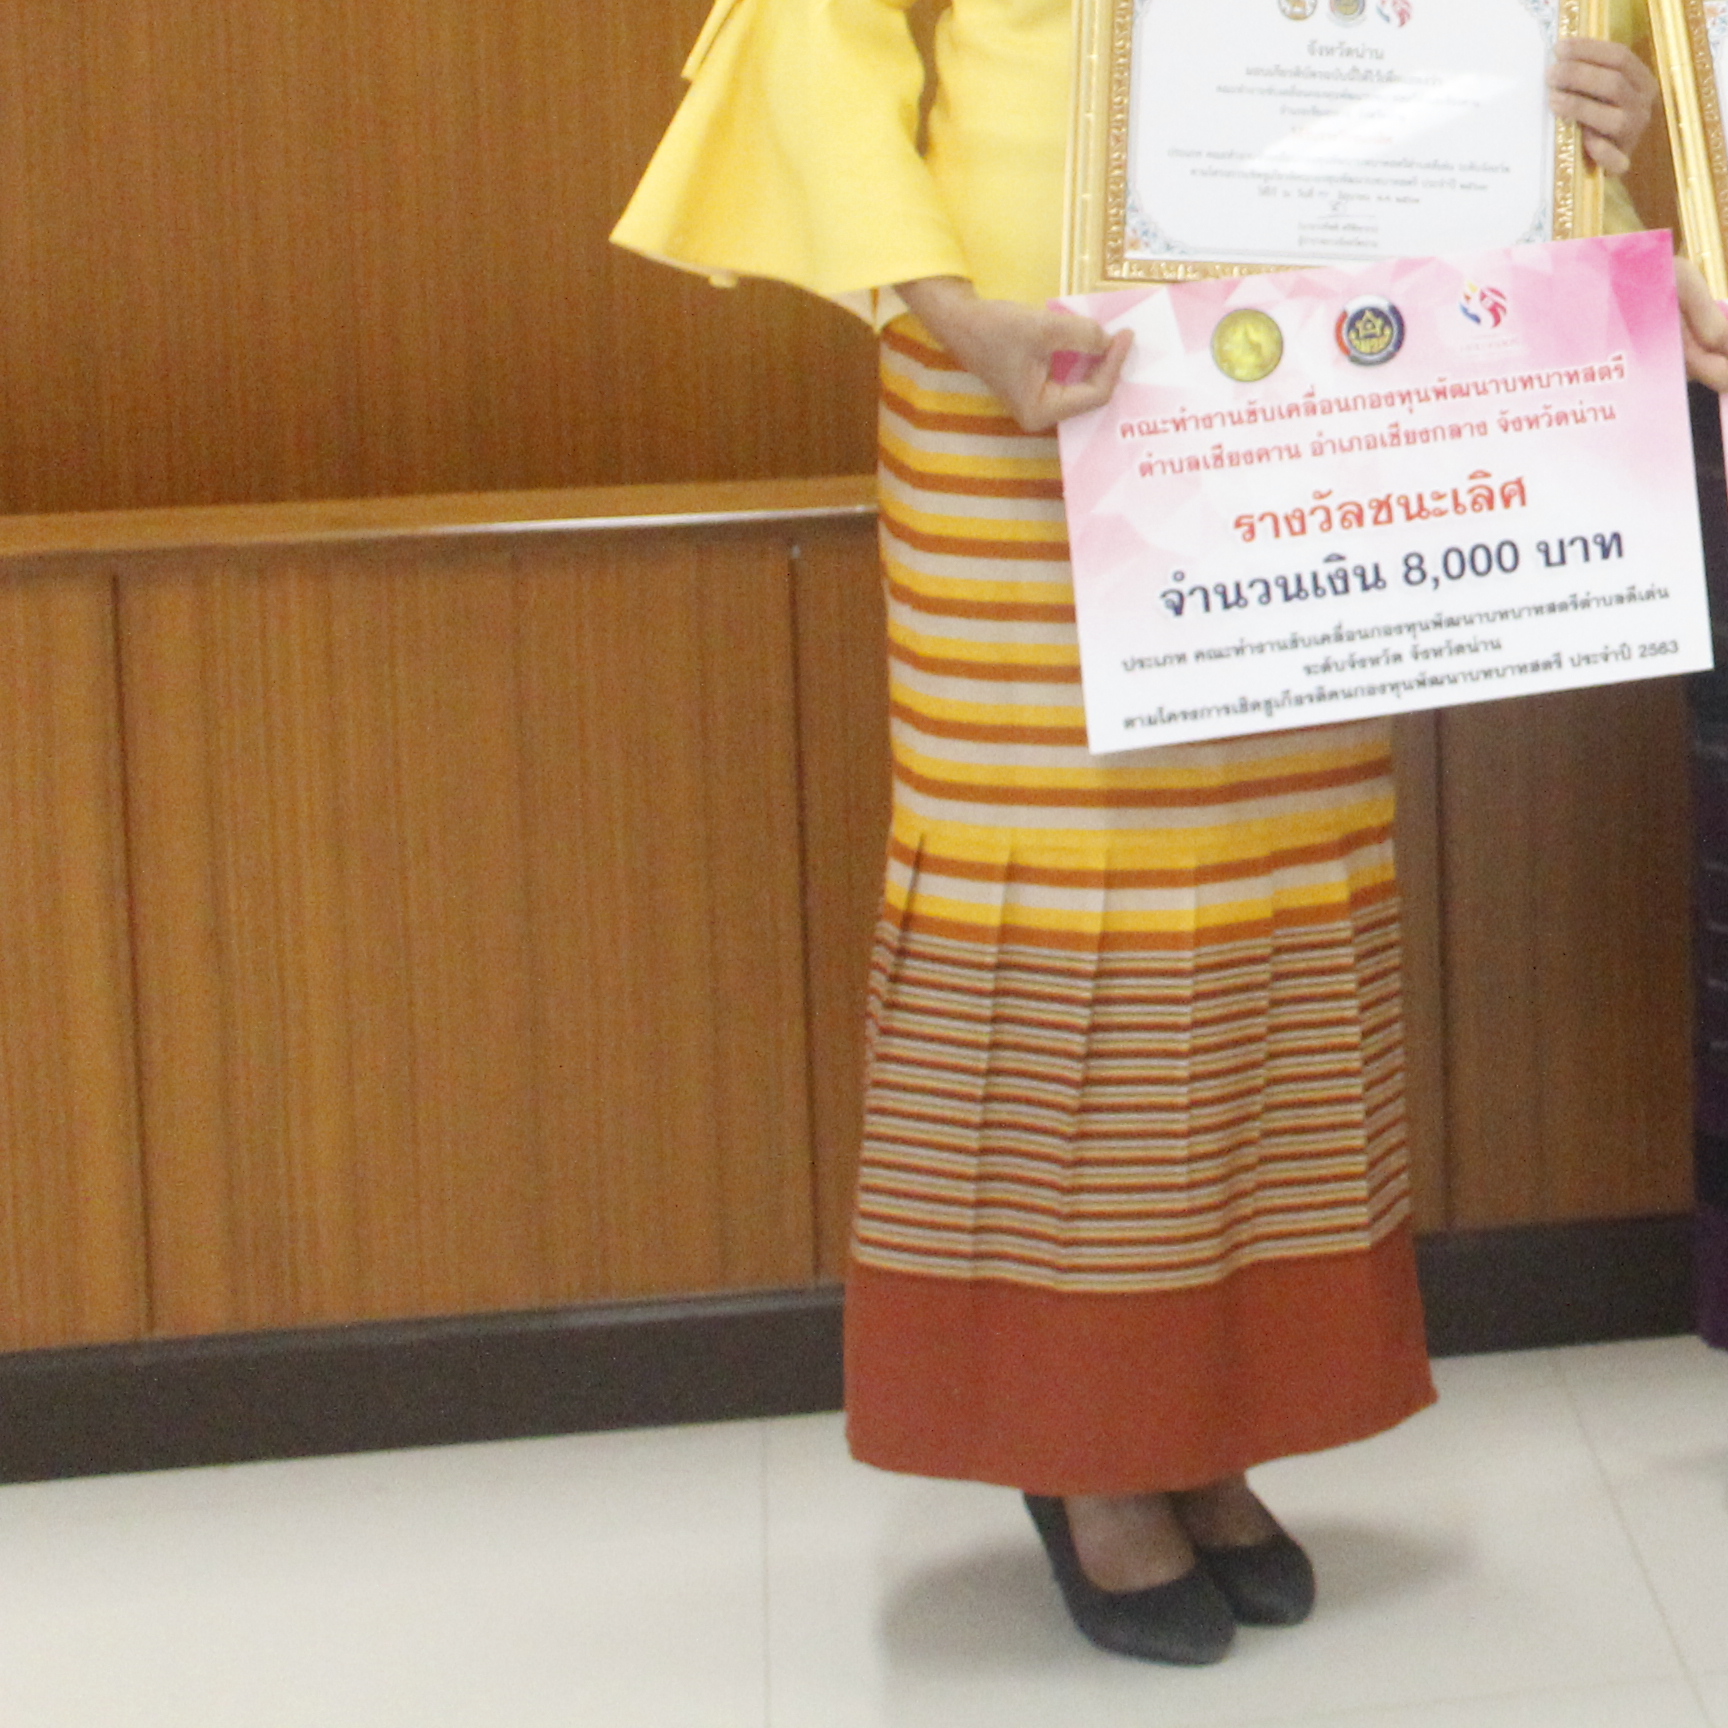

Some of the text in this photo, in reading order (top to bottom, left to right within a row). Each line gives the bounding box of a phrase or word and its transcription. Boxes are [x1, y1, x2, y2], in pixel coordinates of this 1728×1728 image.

[1498, 402, 1615, 433] จังหวัดน่าน
[1234, 470, 1527, 543] รางวัลชนะเลิศ
[1160, 531, 1624, 617] จำนวนเงิน 8,000 บาท
[1409, 637, 1502, 660] จังหวัดน่าน
[1639, 640, 1679, 658] 2563
